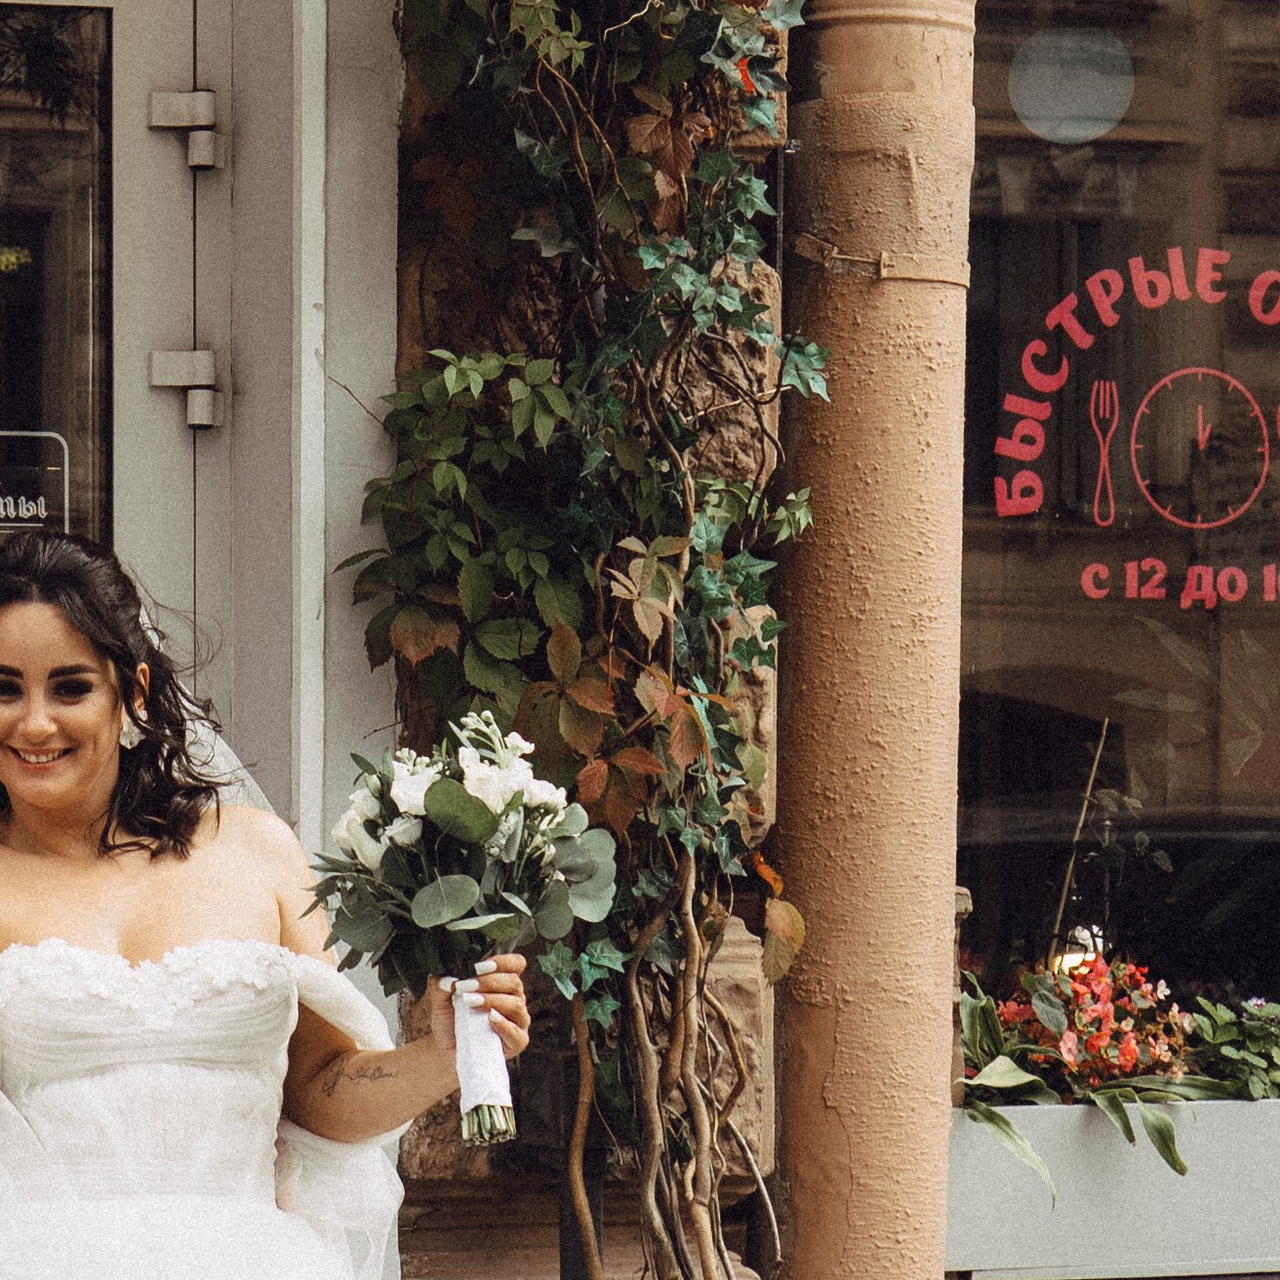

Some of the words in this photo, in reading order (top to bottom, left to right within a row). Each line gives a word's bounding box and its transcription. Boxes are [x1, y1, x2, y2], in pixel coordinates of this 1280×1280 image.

[993, 245, 1231, 518] БЫСТРЫЕ
[1123, 556, 1168, 600] 12
[1262, 562, 1280, 602] 1
